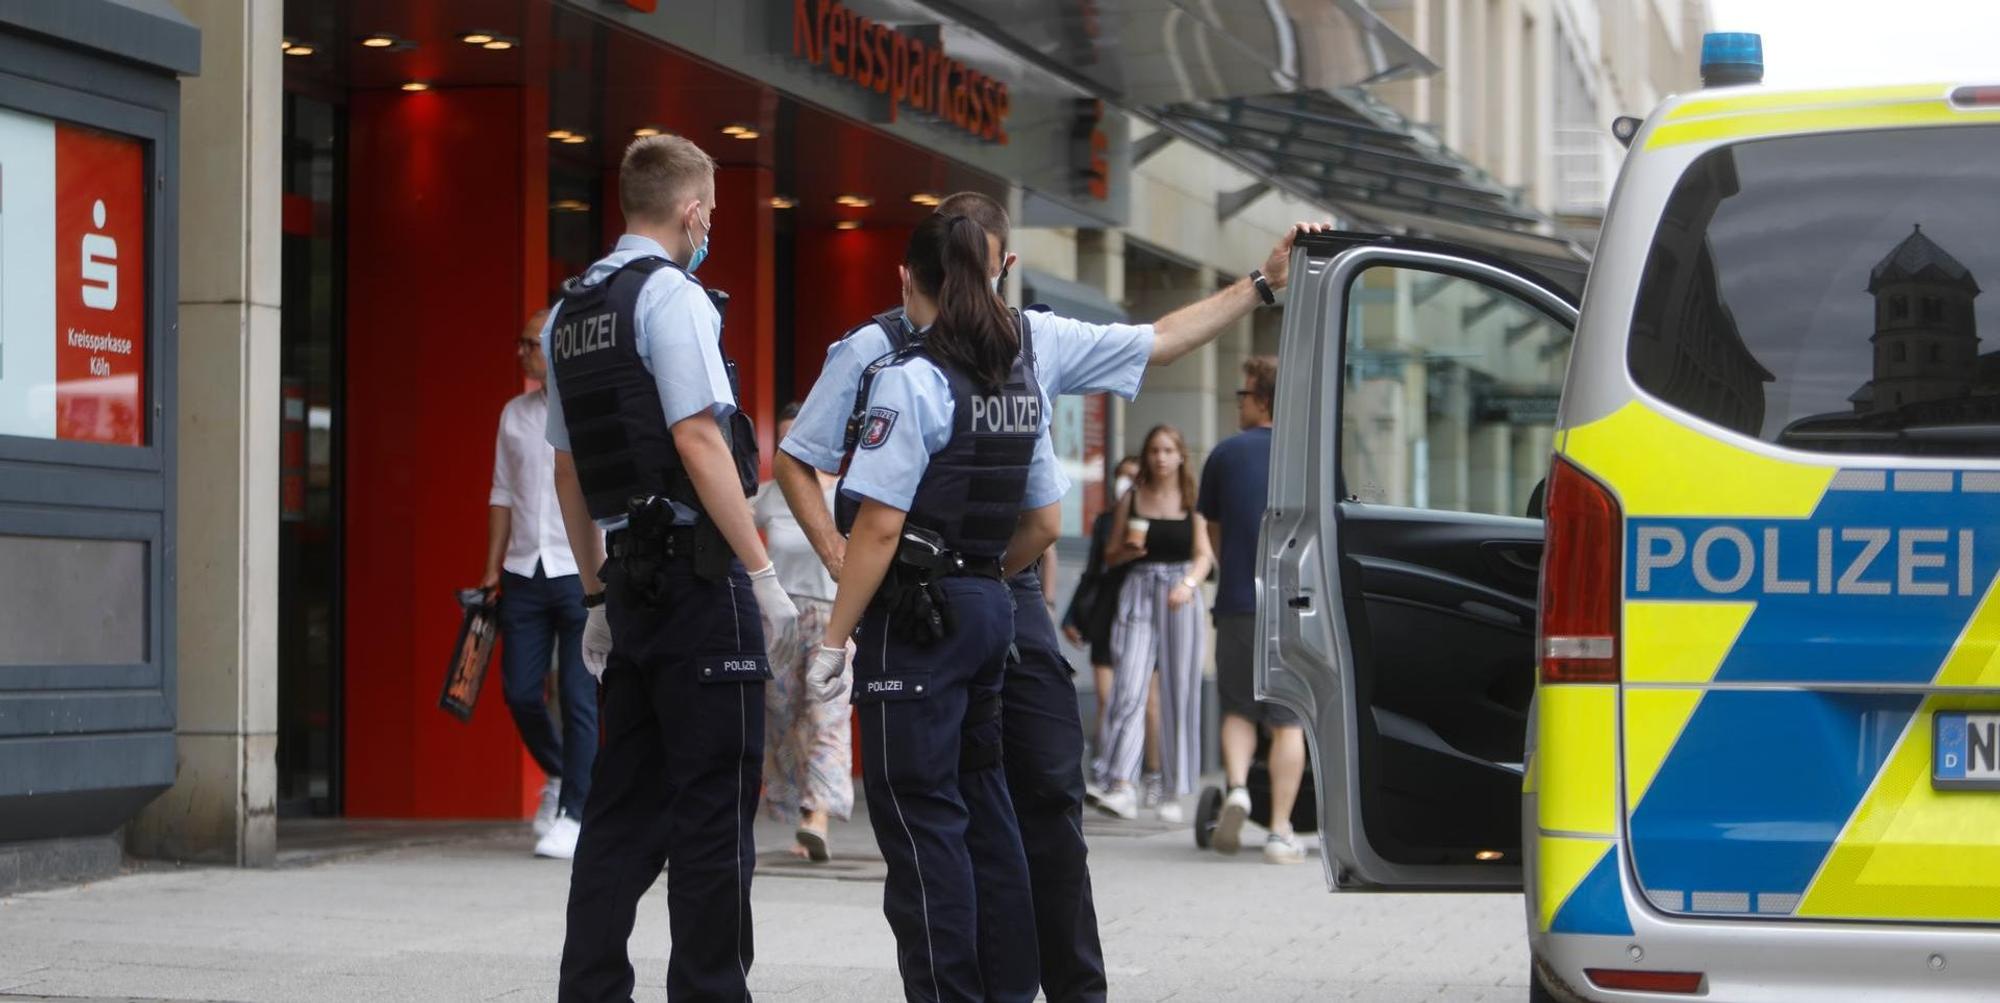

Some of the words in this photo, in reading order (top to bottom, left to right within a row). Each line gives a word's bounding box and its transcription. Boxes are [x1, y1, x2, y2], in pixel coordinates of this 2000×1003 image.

[67, 328, 132, 354] Kreissparkasse
[554, 312, 617, 363] POLIZEI
[90, 357, 111, 377] Köln
[1635, 526, 1975, 596] POLIZEI
[724, 660, 757, 671] POLIZEI
[868, 680, 903, 692] POLIZEI
[1967, 722, 2000, 772] N
[1945, 753, 1958, 768] D
